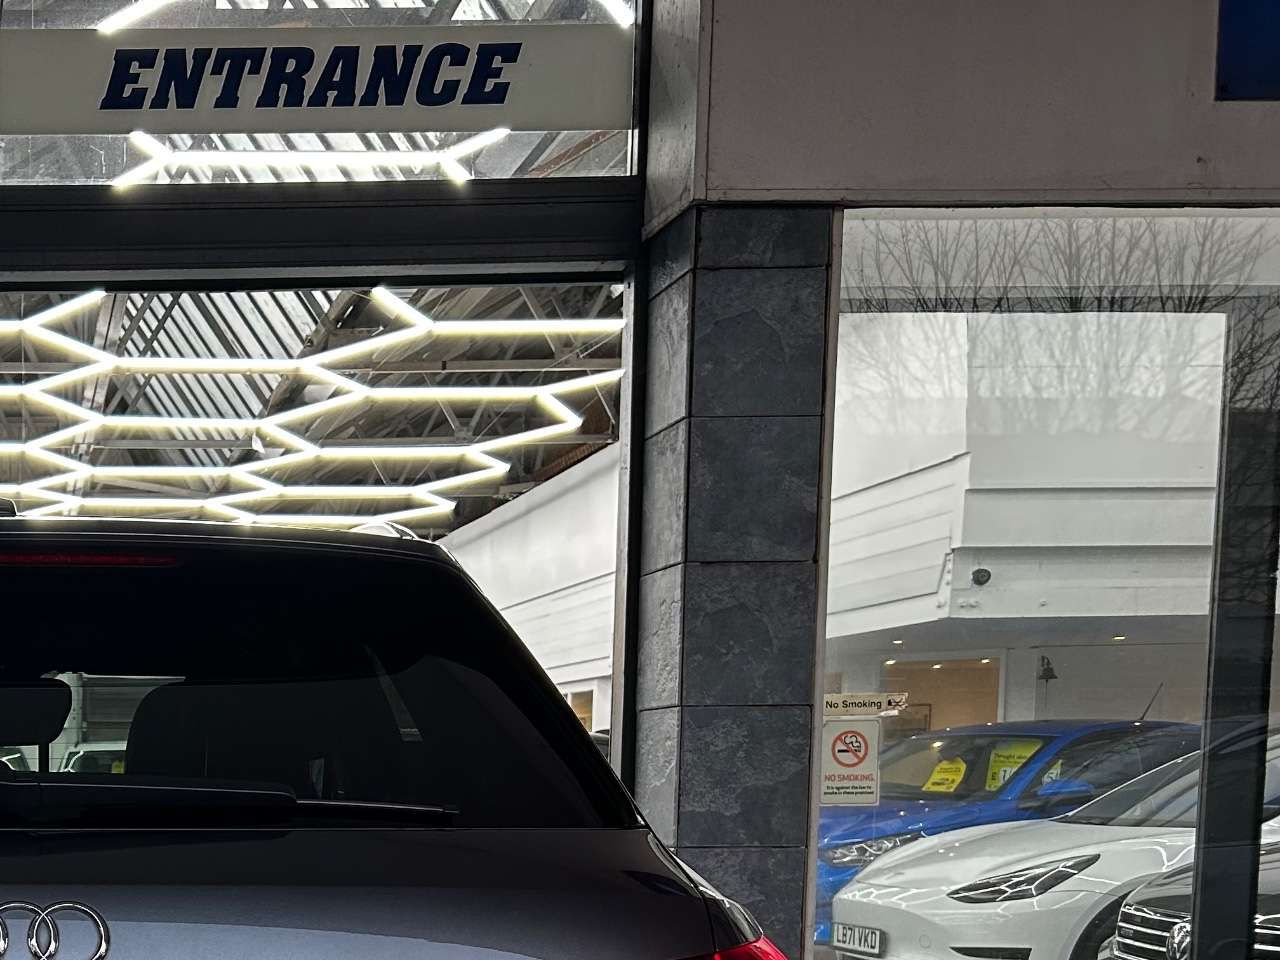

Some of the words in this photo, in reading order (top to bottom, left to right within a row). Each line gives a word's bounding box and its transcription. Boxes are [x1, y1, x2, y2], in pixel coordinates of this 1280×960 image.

[98, 42, 523, 111] ENTRANCE
[825, 701, 839, 709] No
[842, 700, 882, 710] Smoking
[824, 773, 836, 782] NO
[836, 925, 856, 946] LB71
[858, 927, 877, 950] VKD
